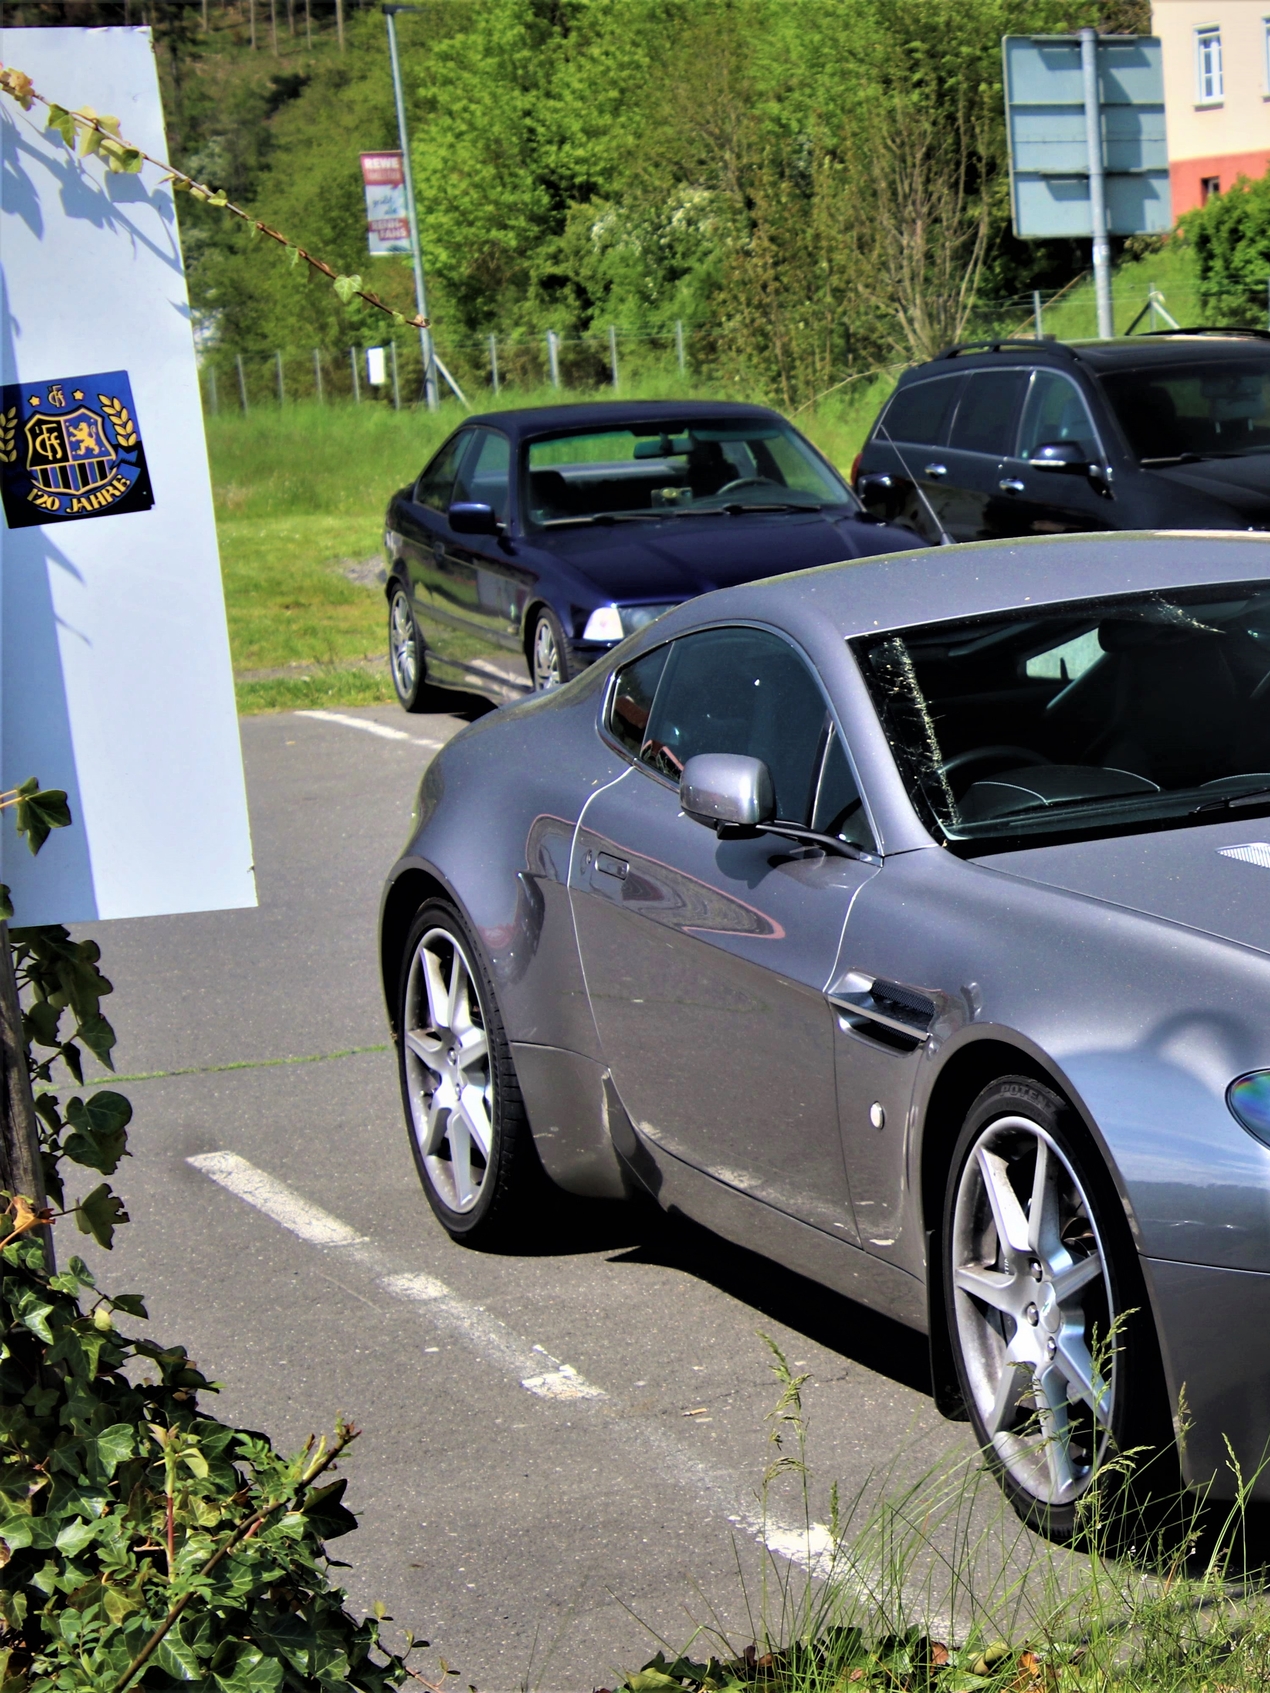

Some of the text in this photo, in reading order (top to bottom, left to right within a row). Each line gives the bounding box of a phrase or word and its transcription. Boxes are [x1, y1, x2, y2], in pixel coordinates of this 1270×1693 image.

[363, 157, 400, 170] REWE
[380, 227, 406, 239] FANS
[27, 474, 131, 513] 120 JAHRE
